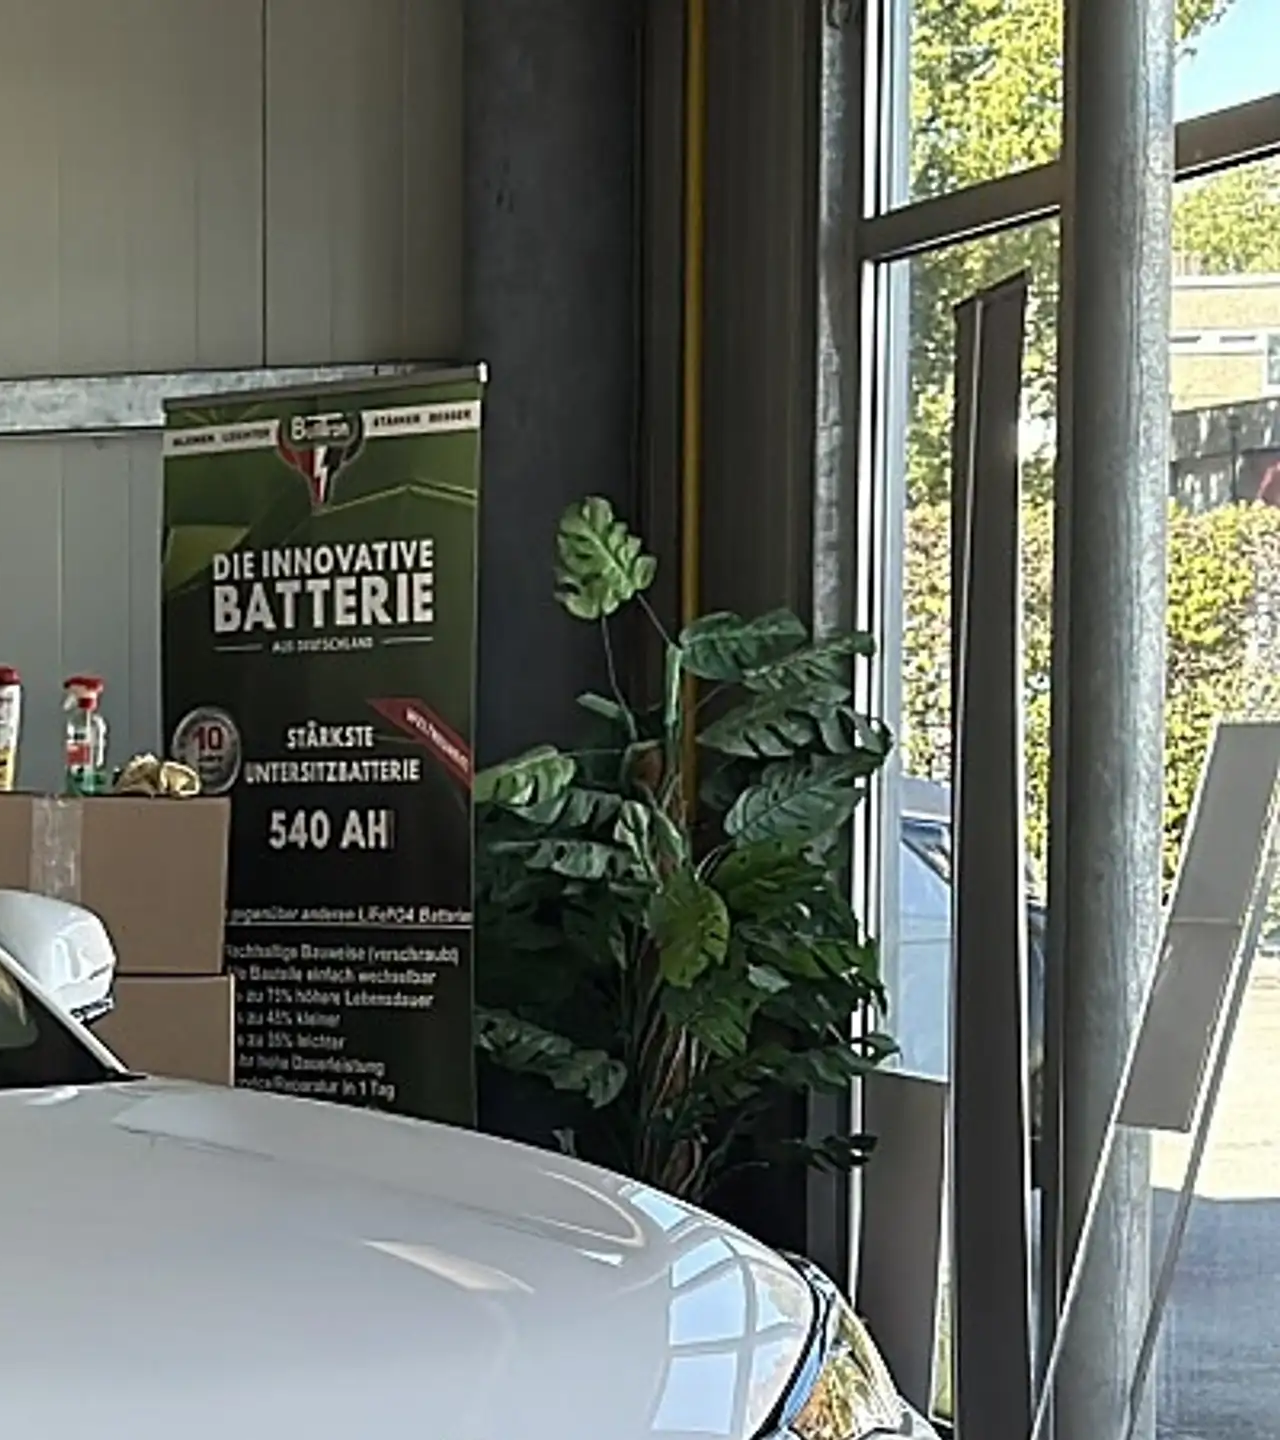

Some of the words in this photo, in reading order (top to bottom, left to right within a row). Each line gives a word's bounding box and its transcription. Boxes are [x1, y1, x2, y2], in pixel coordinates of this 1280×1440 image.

[213, 552, 256, 580] DIE
[261, 539, 434, 579] INNOVATIVE
[213, 572, 434, 633] BATTERIE
[193, 726, 224, 751] 10
[286, 720, 374, 750] STÄRKSTE
[244, 758, 421, 785] UNTERSITZBATTERIE
[268, 809, 331, 850] 540
[340, 808, 392, 850] AH
[370, 1080, 396, 1102] Tag
